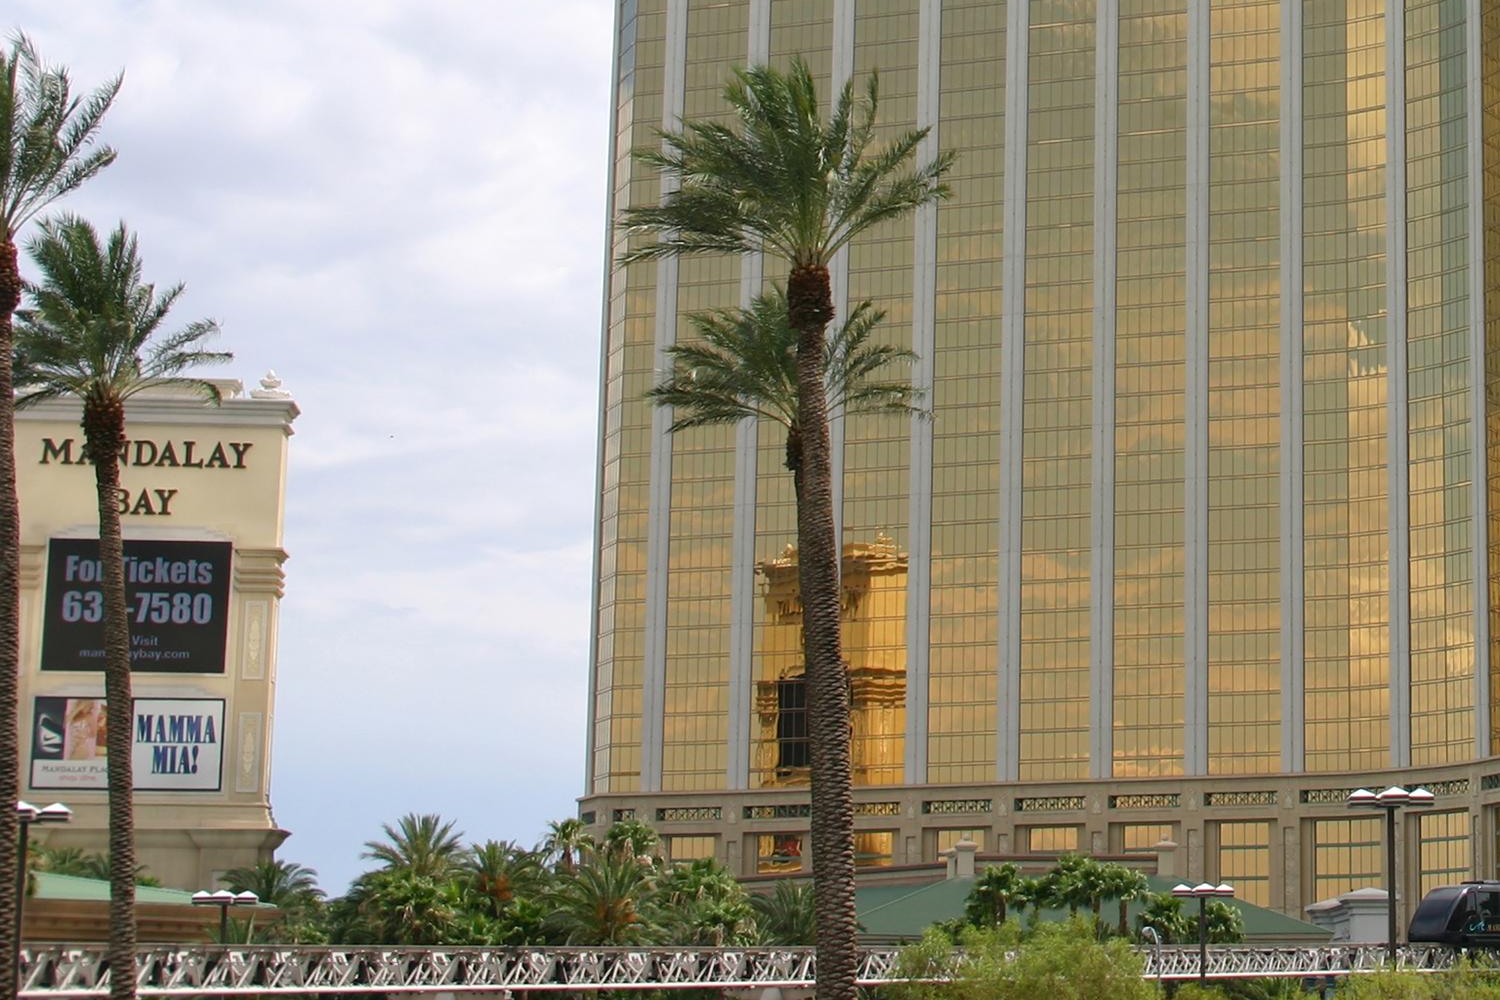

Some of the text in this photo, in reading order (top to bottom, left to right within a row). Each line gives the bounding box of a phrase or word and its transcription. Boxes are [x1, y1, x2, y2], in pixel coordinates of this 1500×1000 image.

[124, 557, 213, 585] ickets
[62, 590, 213, 625] 63-7580
[79, 649, 190, 660] manybay.com
[132, 635, 158, 646] Visit
[136, 715, 216, 744] MAMMA
[151, 745, 199, 775] MIA!
